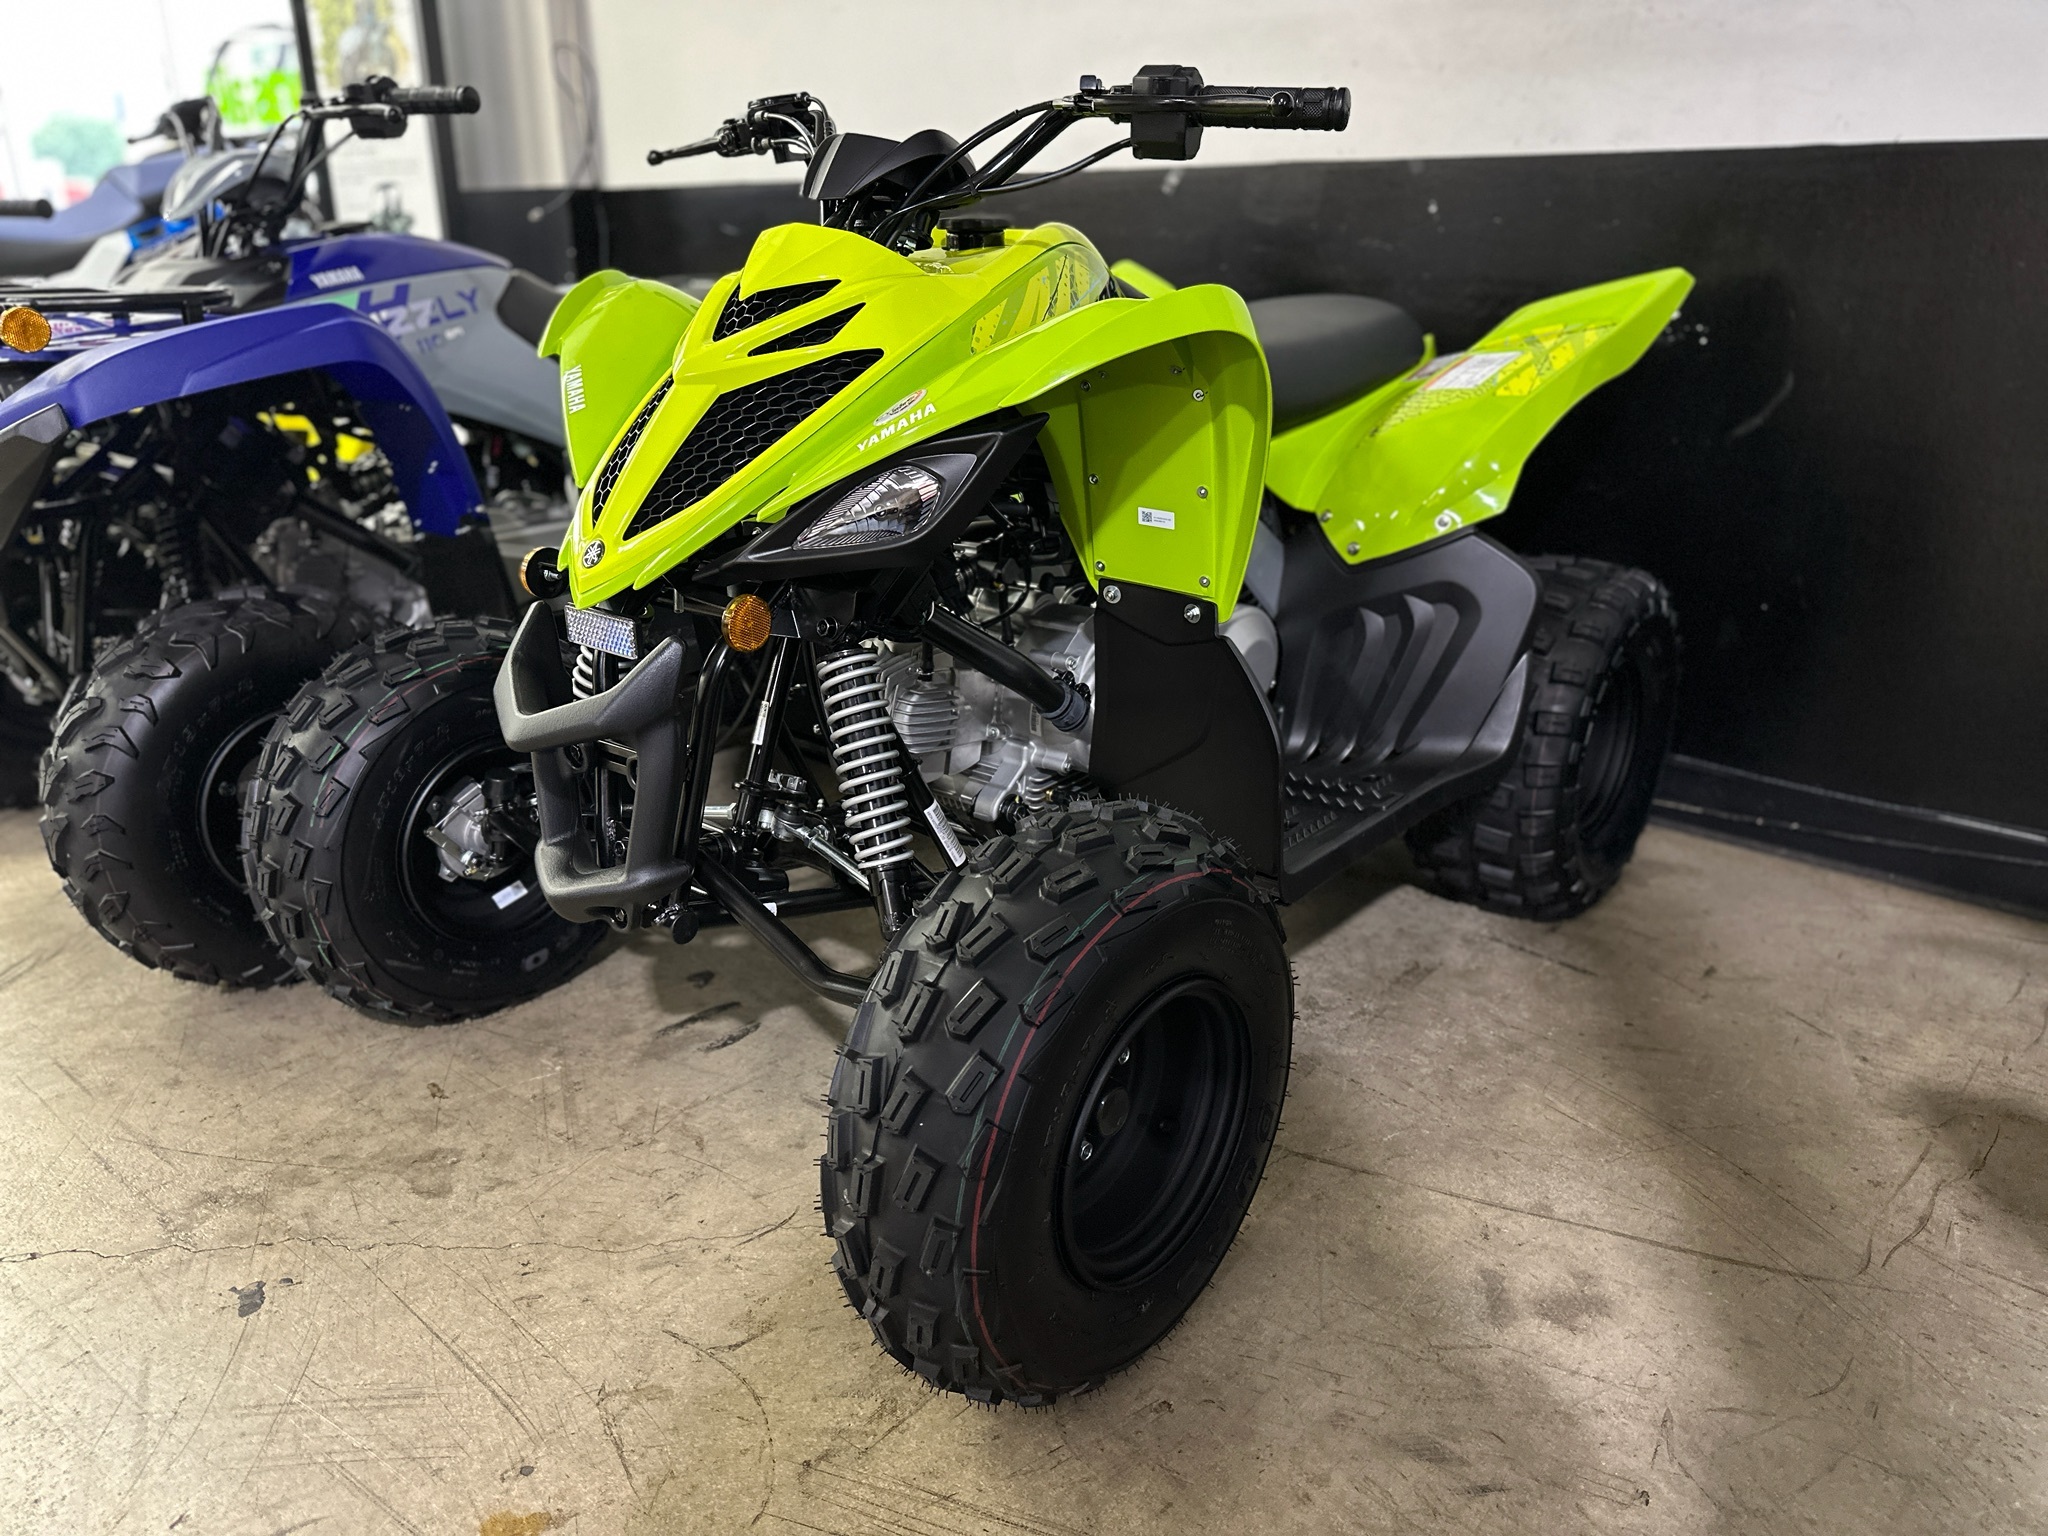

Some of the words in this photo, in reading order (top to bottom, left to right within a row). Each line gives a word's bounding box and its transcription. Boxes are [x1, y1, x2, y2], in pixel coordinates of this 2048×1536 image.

[309, 265, 365, 289] YAMAHA
[563, 364, 587, 415] YAMAHA
[856, 403, 937, 452] YAMAHA
